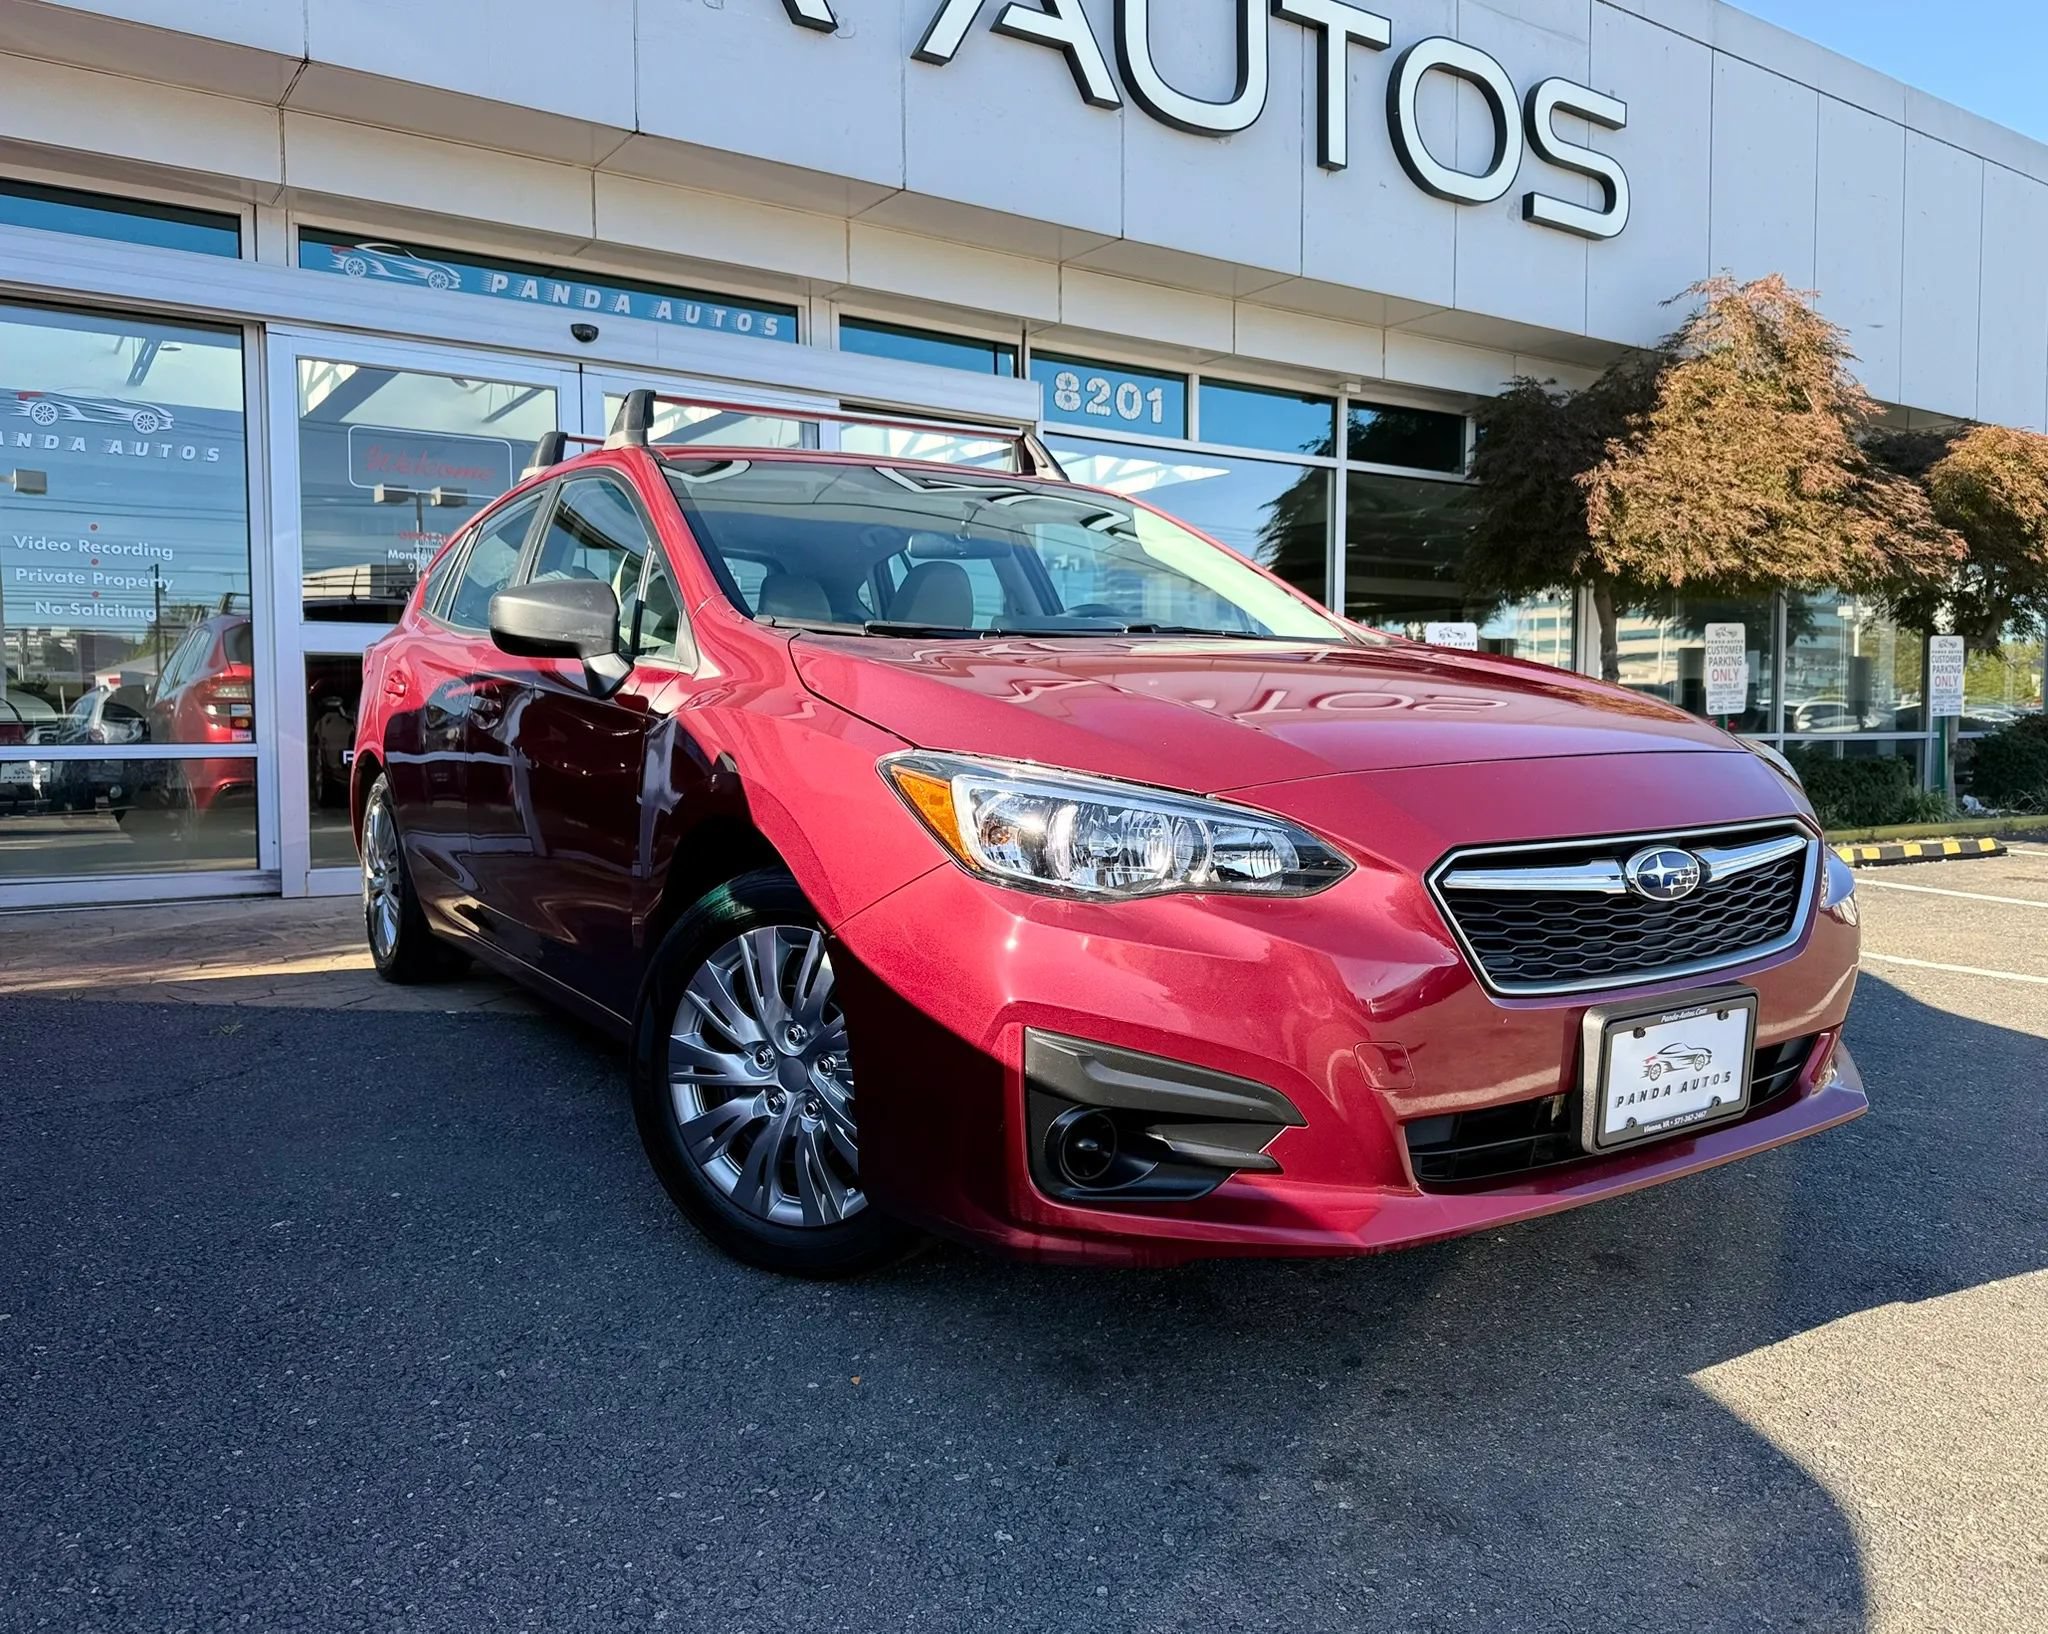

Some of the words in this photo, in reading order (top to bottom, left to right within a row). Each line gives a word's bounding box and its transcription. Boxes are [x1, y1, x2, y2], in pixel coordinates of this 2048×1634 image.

[489, 271, 632, 315] PANDA
[655, 300, 779, 336] AUTOS
[1053, 371, 1163, 424] 8201
[108, 439, 221, 462] AUTOS
[13, 535, 72, 552] Video
[78, 539, 174, 561] Recording
[15, 568, 86, 585] Private
[92, 571, 174, 592] Property
[35, 601, 63, 615] No
[70, 602, 158, 623] Soliciting
[1707, 645, 1743, 655] CUSTOMER
[1931, 654, 1962, 664] CUSTOMER
[1708, 656, 1743, 667] PARKING
[1932, 665, 1962, 674] PARKING
[1711, 668, 1740, 682] ONLY
[1935, 676, 1959, 687] ONLY
[1616, 1085, 1671, 1108] PANDA
[1680, 1071, 1732, 1093] AUTOS
